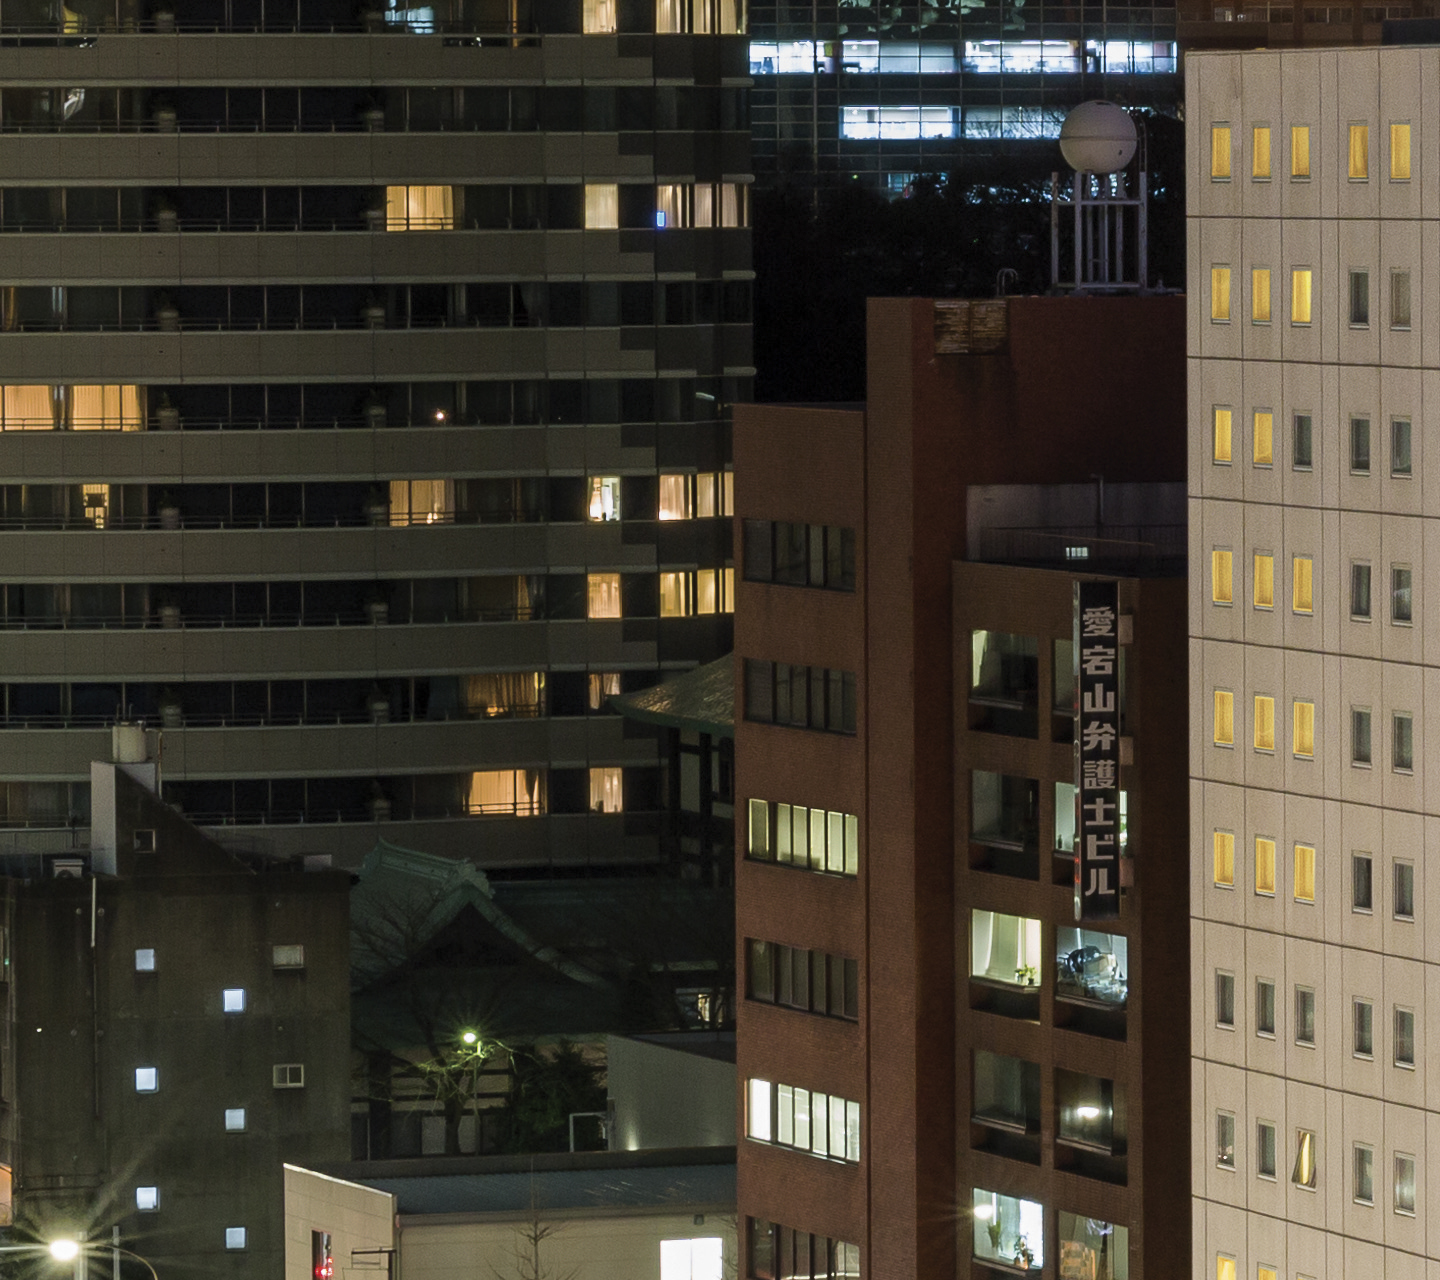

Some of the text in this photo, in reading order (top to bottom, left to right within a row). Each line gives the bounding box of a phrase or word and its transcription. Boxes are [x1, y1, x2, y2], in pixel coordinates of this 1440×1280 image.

[1082, 606, 1116, 896] 愛宕山弁護士ビル
